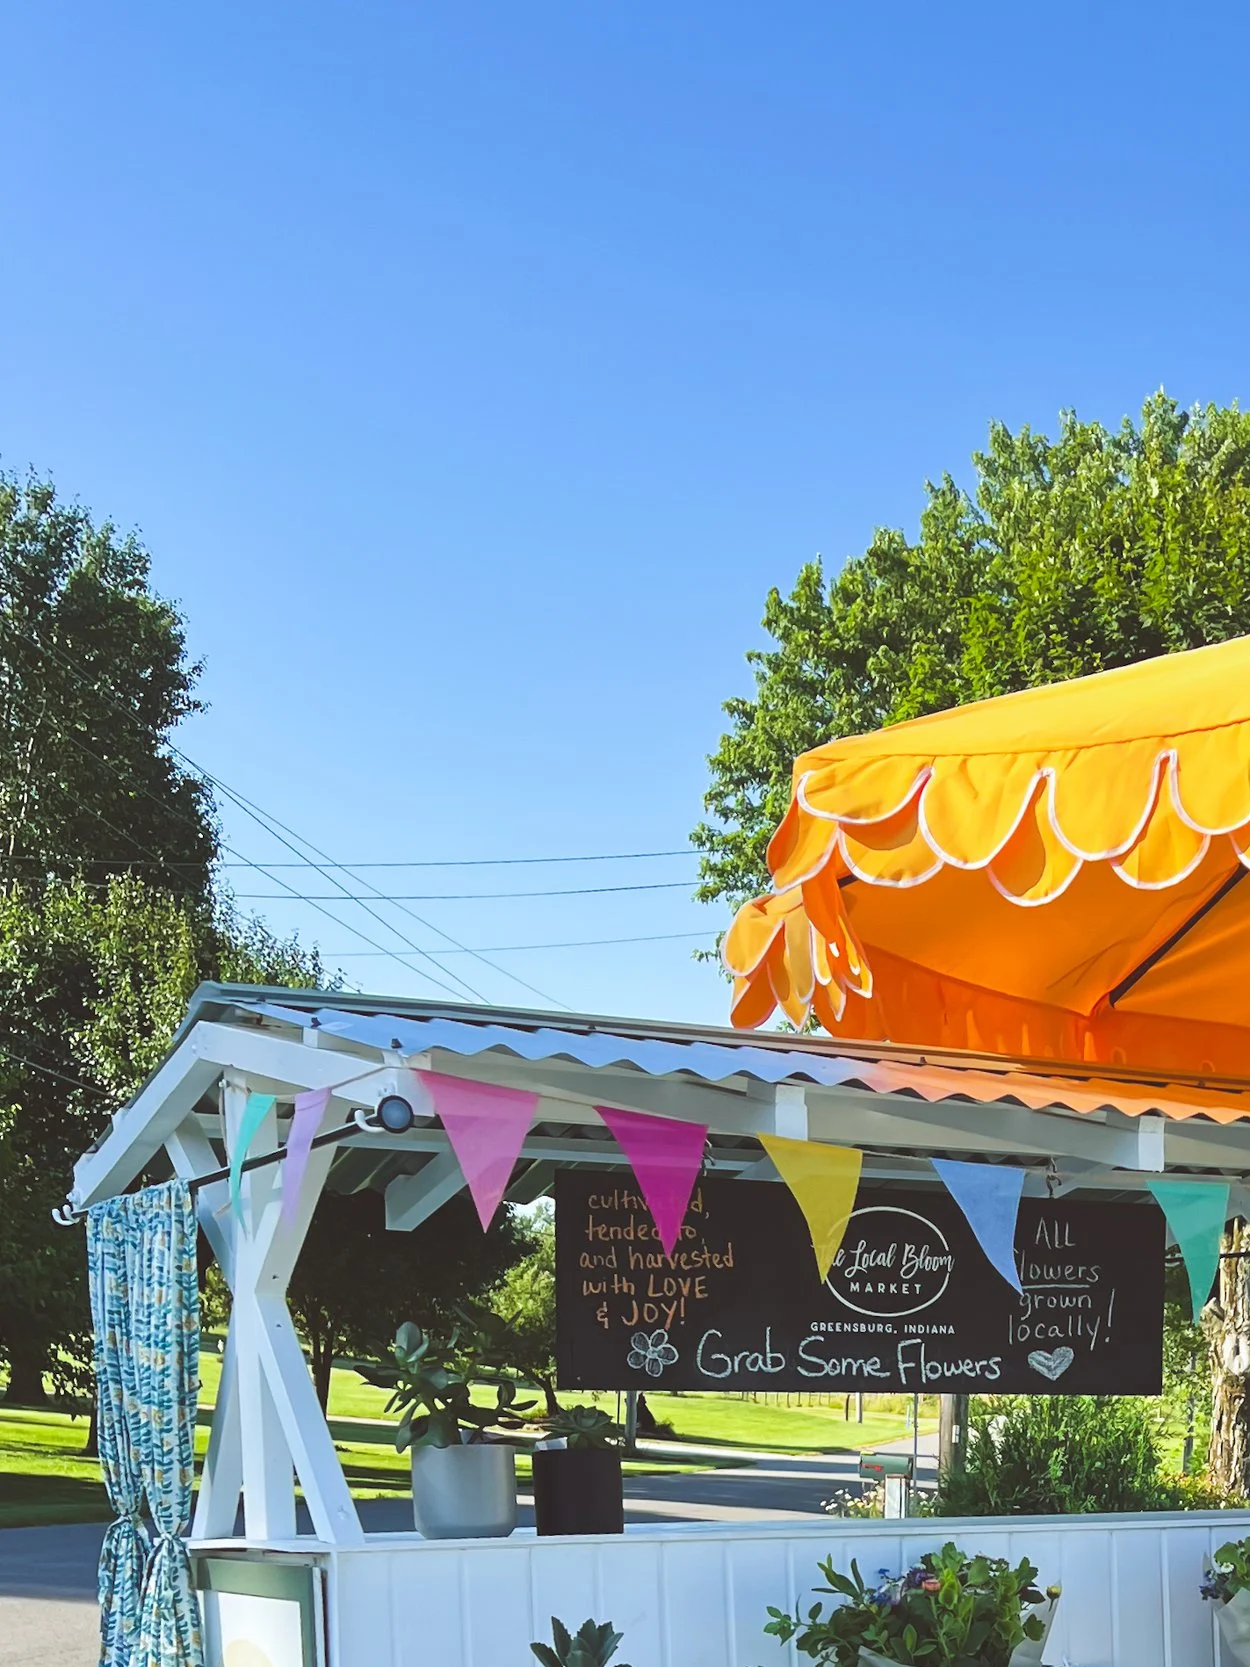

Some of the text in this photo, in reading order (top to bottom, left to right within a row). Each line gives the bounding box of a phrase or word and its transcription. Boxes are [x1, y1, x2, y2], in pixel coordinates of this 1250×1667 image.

[579, 1241, 734, 1271] and harvested
[844, 1240, 898, 1278] Local
[900, 1243, 956, 1279] Bloom
[1014, 1248, 1101, 1283] lowers
[582, 1273, 709, 1299] with LOVE
[850, 1282, 922, 1295] MARKET
[620, 1296, 686, 1331] JOY!
[1008, 1288, 1115, 1351] locally!
[1019, 1292, 1092, 1321] grown
[904, 1324, 956, 1335] INDIANA
[696, 1327, 1003, 1385] Grab Some Flowers
